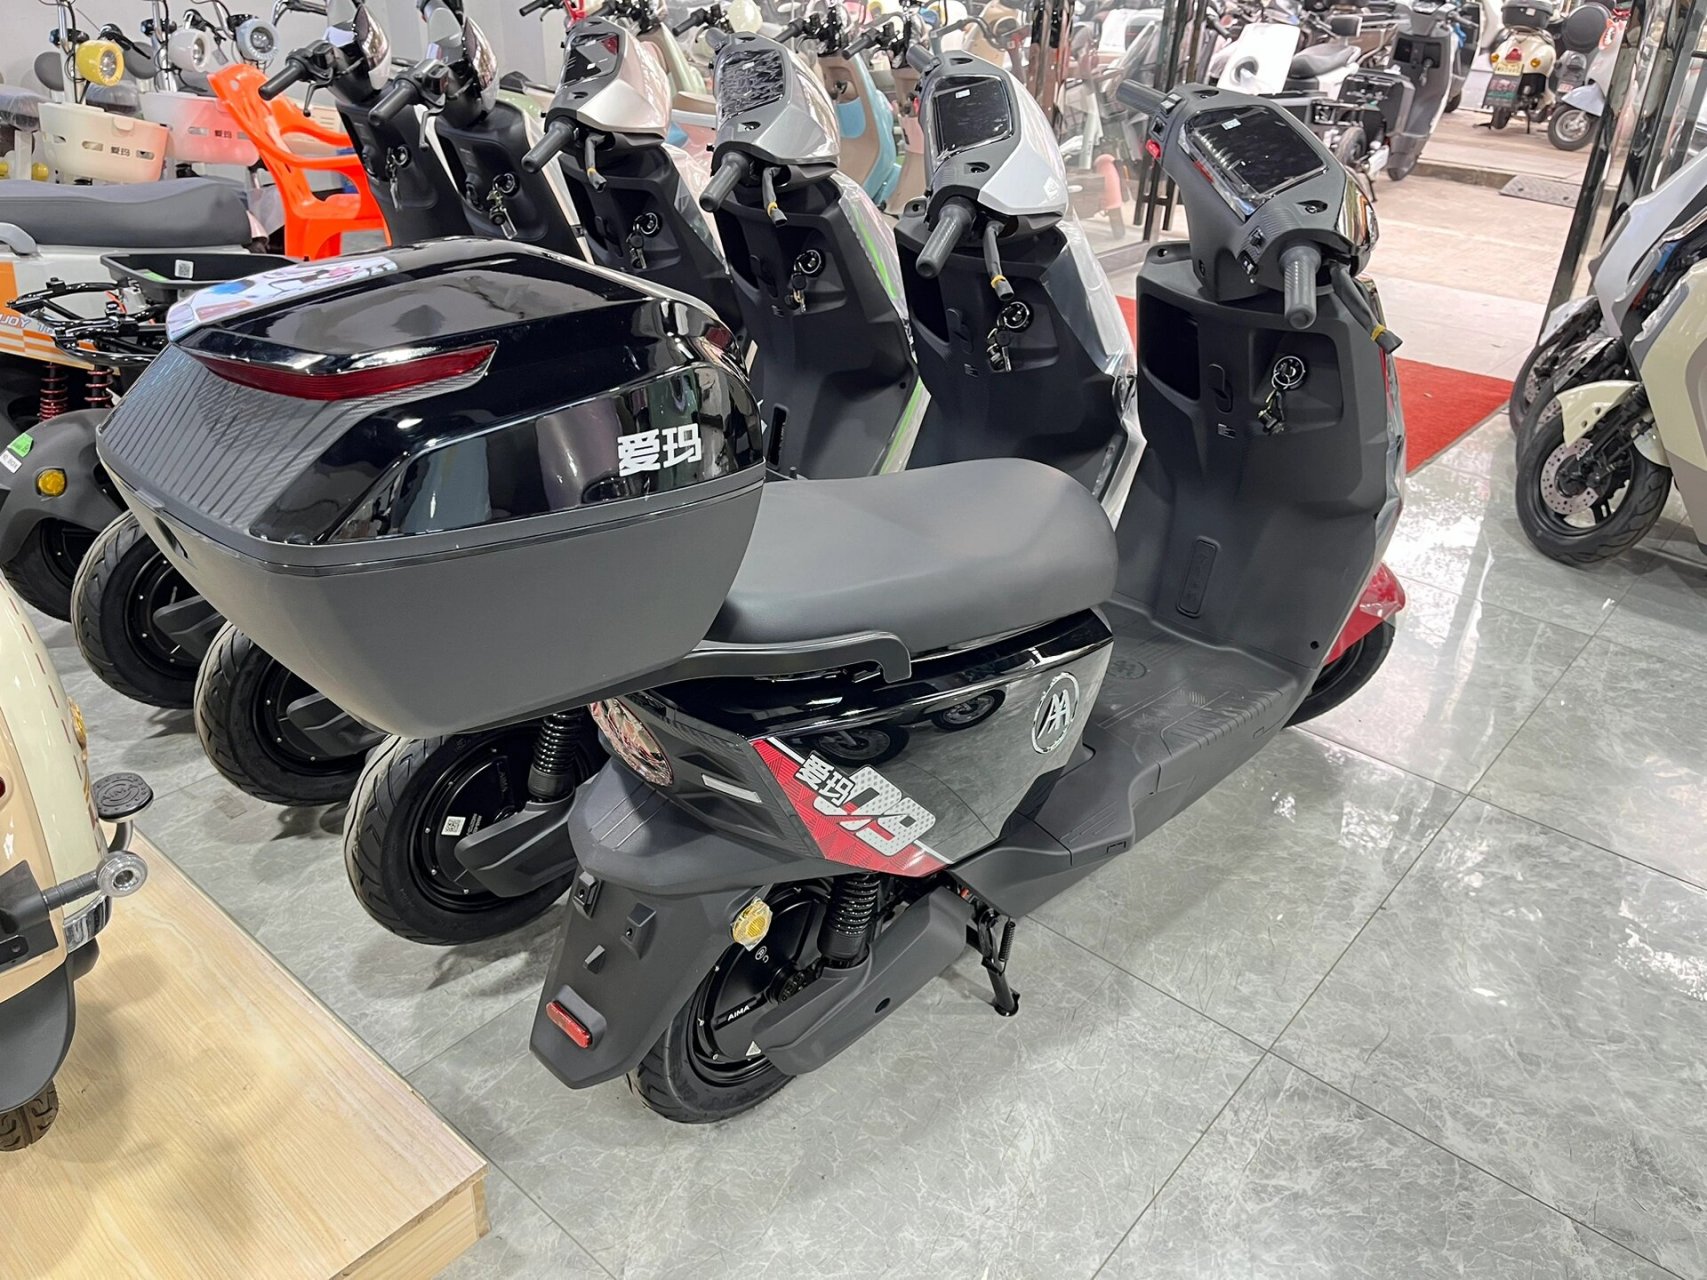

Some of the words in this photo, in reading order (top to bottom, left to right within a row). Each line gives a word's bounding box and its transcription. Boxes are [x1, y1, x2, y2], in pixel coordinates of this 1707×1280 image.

[110, 146, 131, 157] 爱玛
[617, 422, 702, 477] 爱玛
[794, 753, 855, 807] 爱玛
[727, 1004, 751, 1021] AIMA
